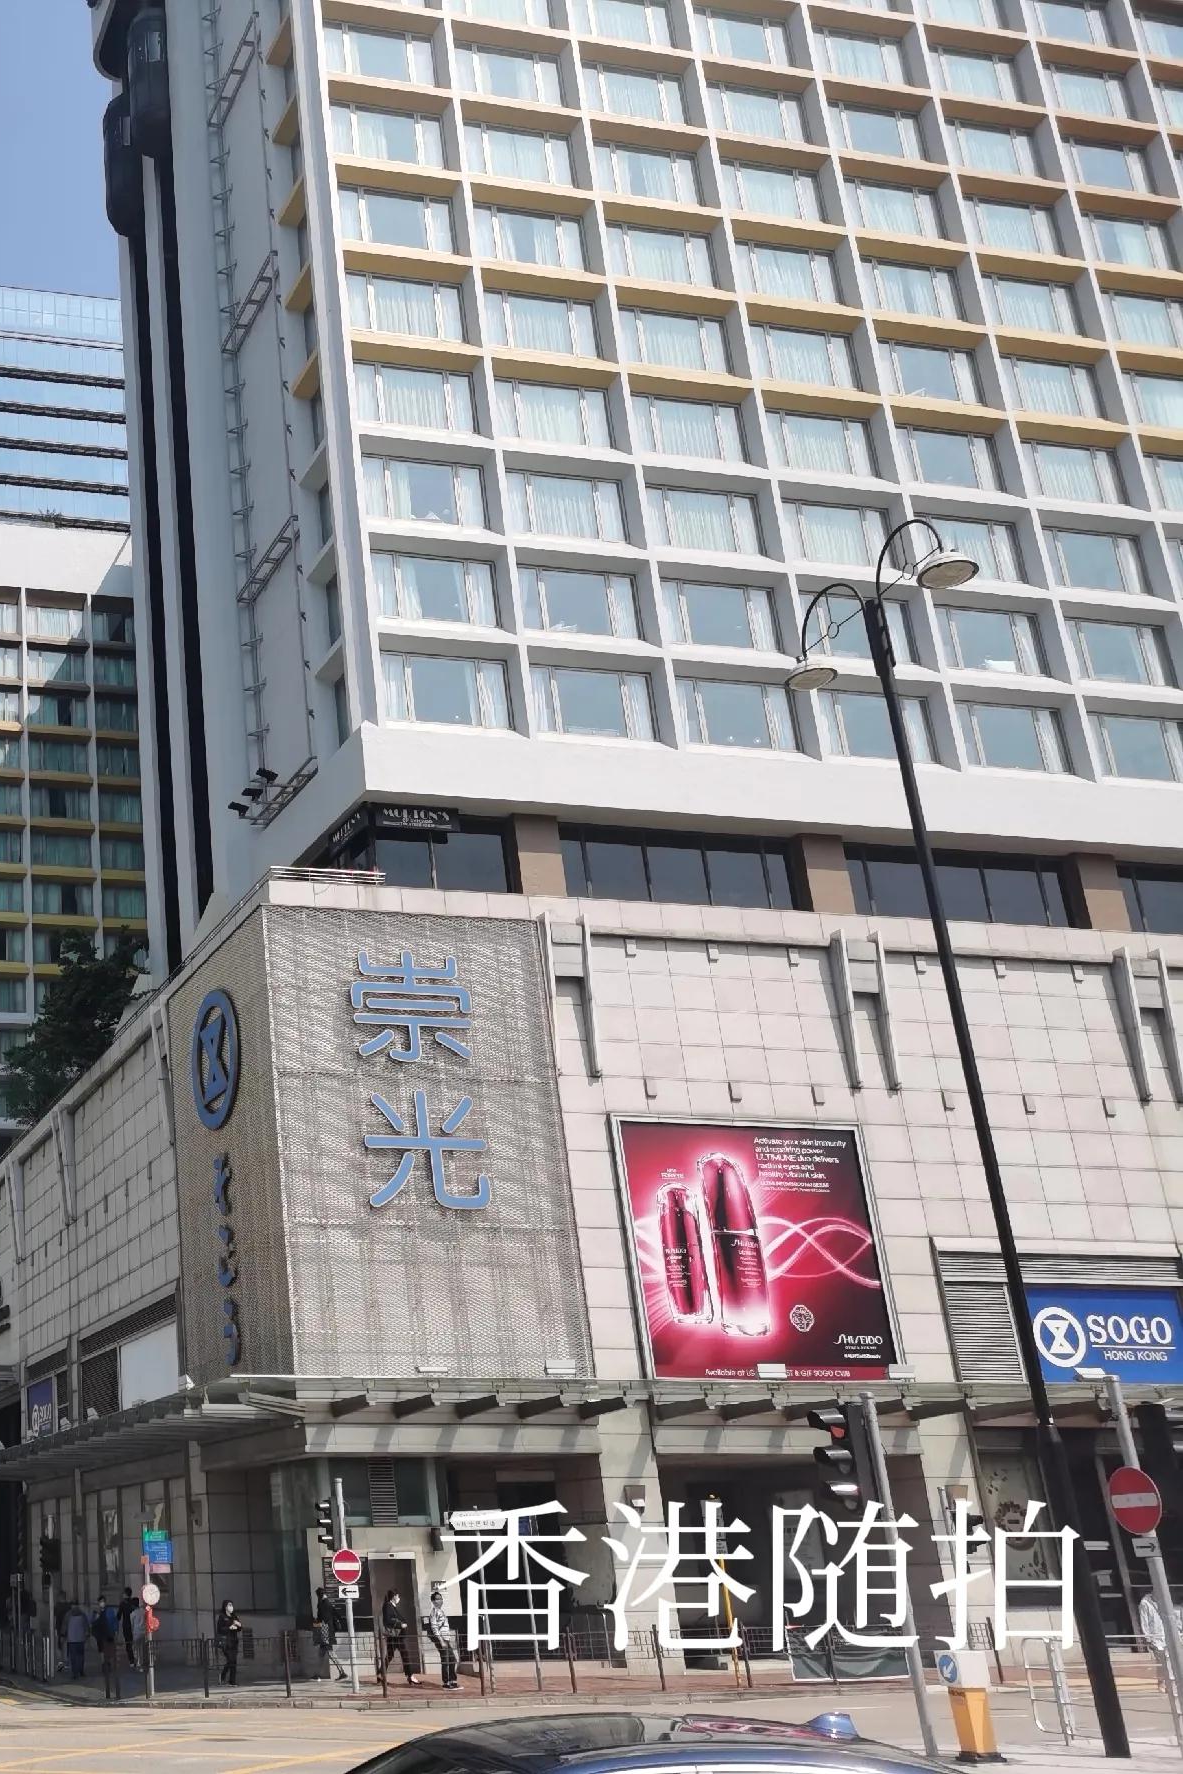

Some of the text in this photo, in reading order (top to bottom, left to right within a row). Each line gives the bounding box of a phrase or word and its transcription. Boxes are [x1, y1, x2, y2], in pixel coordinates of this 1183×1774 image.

[382, 807, 450, 821] MORTON'S
[349, 950, 492, 1211] 崇光
[800, 1138, 814, 1146] skin
[815, 1139, 846, 1148] immunity
[812, 1155, 839, 1164] delivers
[1085, 1314, 1173, 1344] SOGO
[833, 1333, 883, 1345] SHISEIDO
[1103, 1350, 1168, 1361] HONG KONG
